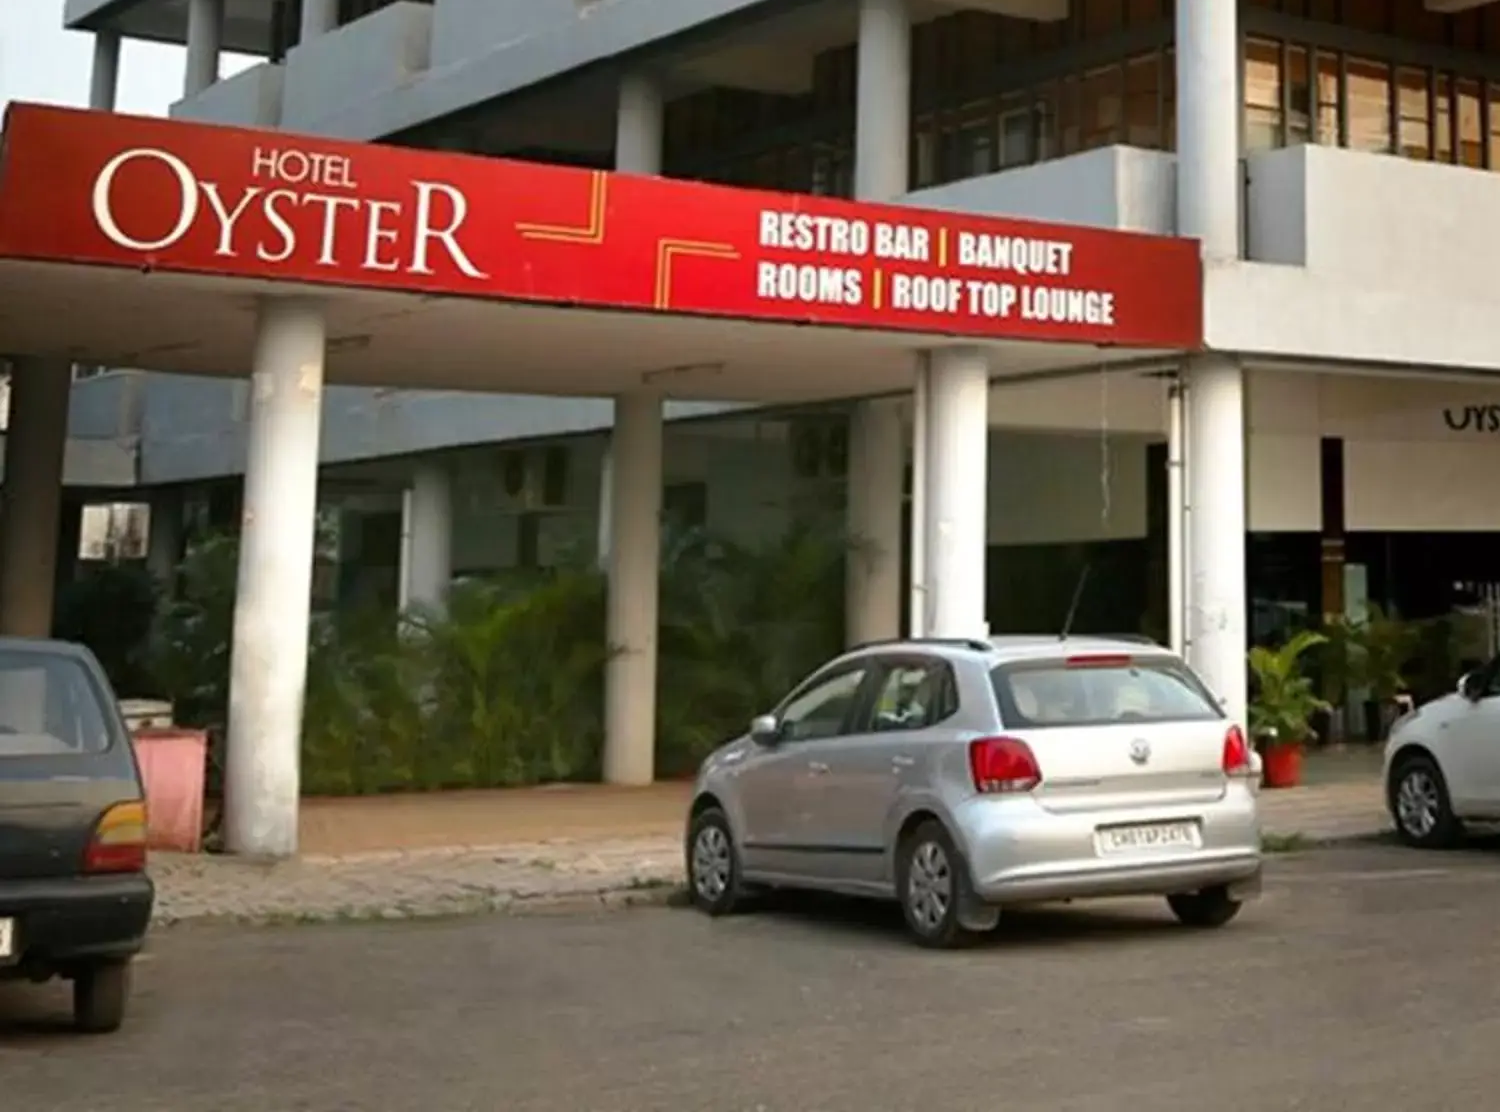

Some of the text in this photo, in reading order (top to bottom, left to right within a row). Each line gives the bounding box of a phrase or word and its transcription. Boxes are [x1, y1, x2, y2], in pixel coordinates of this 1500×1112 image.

[251, 146, 358, 189] HOTEL
[92, 147, 491, 280] OYSTER
[759, 209, 1074, 276] RESTRO BAR BANQUET
[757, 262, 1115, 325] ROOMS ROOF TOP LOUNGE
